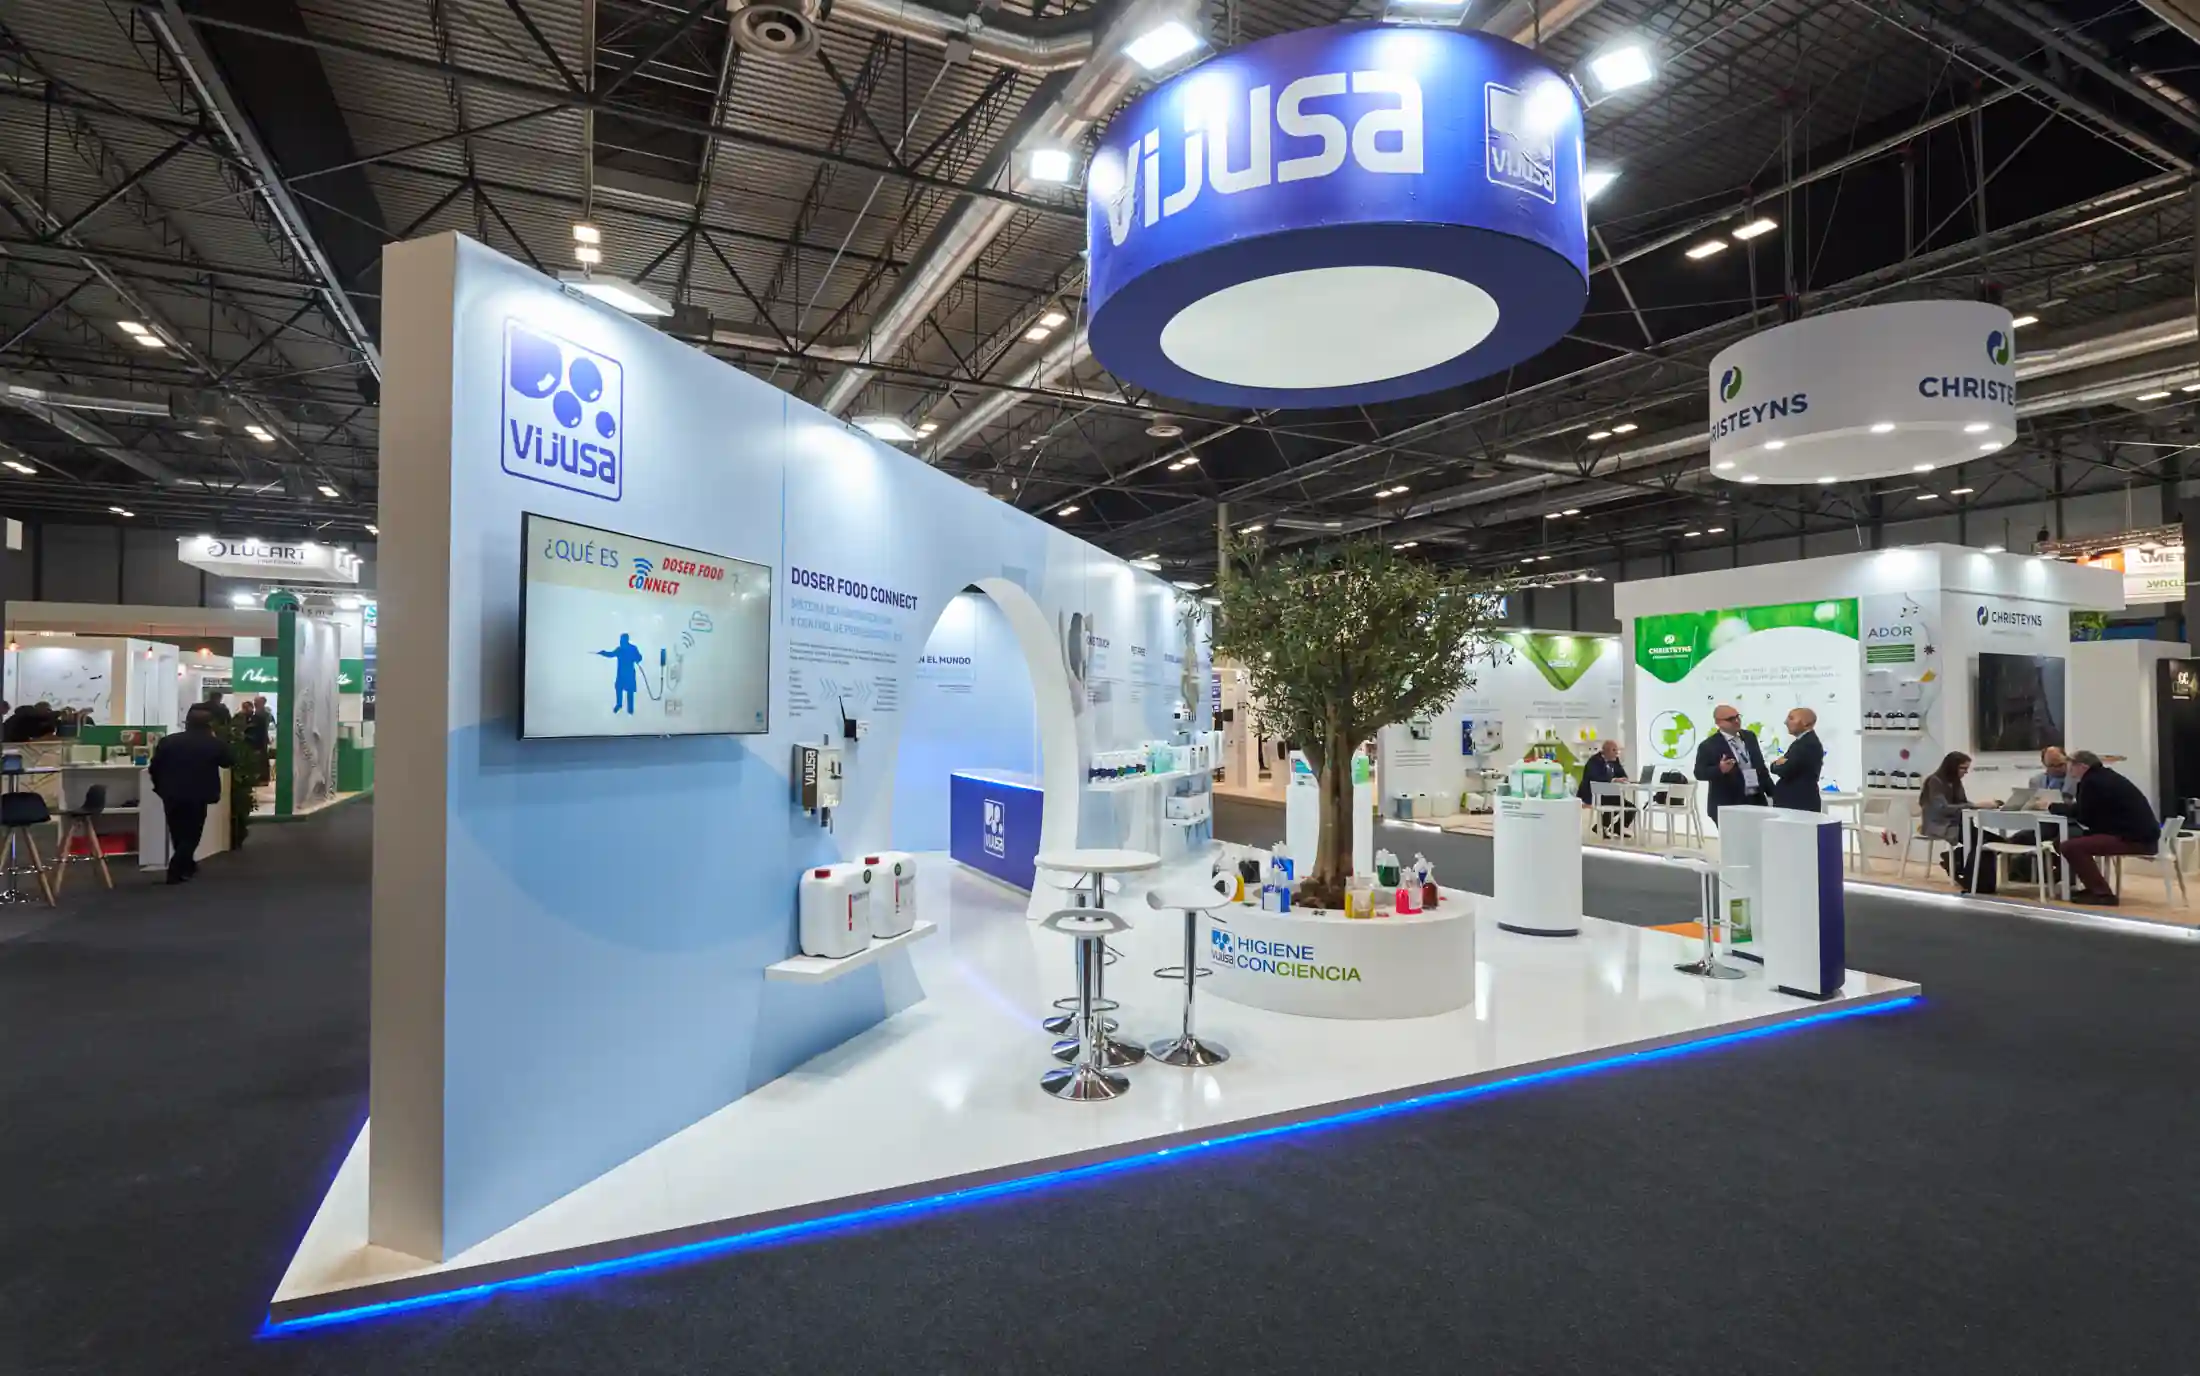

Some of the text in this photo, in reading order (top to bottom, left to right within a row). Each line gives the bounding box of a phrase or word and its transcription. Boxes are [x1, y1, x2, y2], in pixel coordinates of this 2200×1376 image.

[1918, 376, 2014, 406] CHRISTE
[510, 418, 616, 485] Vijusa
[231, 543, 305, 560] LUCART
[544, 538, 619, 569] ¿QUÉ ES
[661, 557, 696, 577] DOSER
[697, 564, 724, 582] FOOD
[628, 573, 681, 596] CONNECT
[791, 566, 919, 611] DOSER FOOD CONNECT
[1991, 611, 2042, 627] CHRISTEYNS
[926, 656, 937, 664] EL
[939, 656, 972, 665] MUNDO
[1238, 936, 1315, 961] HIGIENE
[1237, 954, 1362, 982] CONCIENCIA
